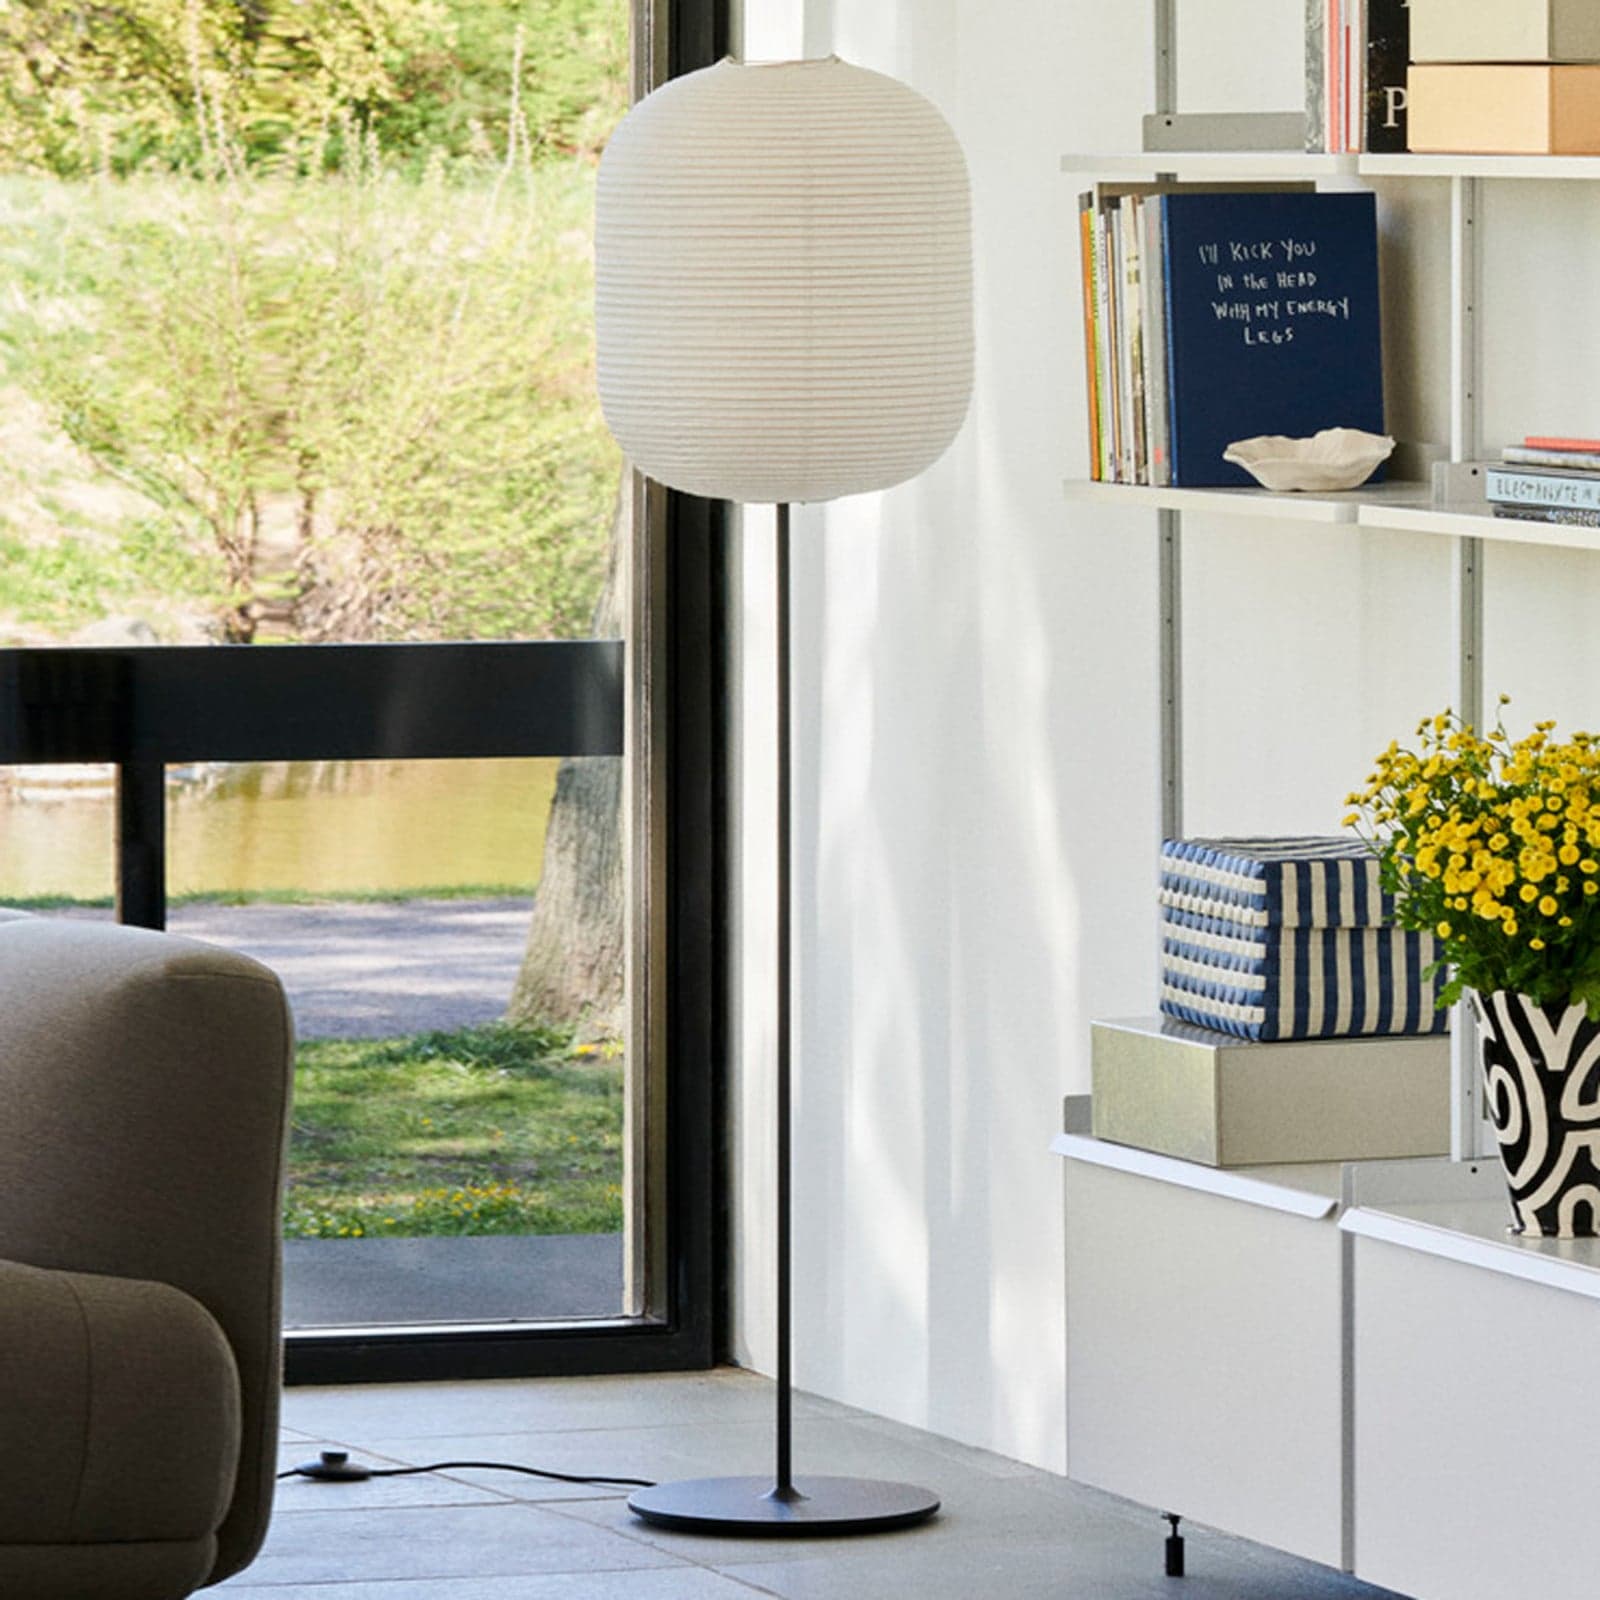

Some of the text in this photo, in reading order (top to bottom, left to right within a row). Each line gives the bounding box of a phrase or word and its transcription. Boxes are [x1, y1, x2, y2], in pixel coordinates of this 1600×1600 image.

[1229, 241, 1273, 262] KICK
[1280, 238, 1316, 262] YOU
[1217, 273, 1234, 292] IN
[1276, 271, 1318, 289] HEAD
[1255, 301, 1279, 320] MY
[1286, 296, 1349, 320] ENERGY
[1244, 327, 1294, 344] LEGS
